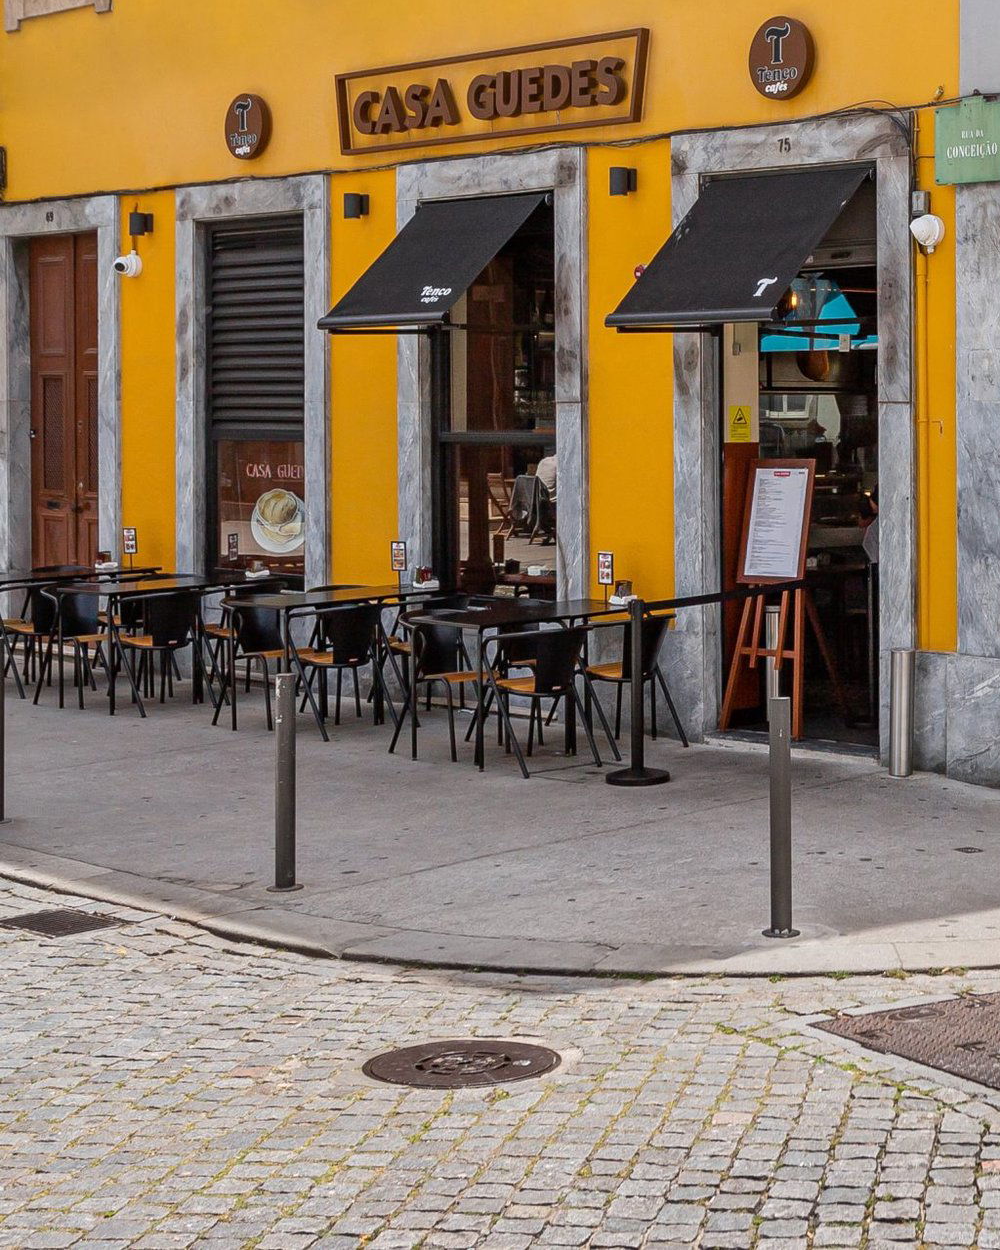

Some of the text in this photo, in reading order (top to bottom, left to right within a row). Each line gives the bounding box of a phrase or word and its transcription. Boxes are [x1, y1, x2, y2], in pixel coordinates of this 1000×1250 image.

[765, 22, 791, 65] T
[757, 65, 798, 83] Tenco
[353, 56, 626, 134] CASA GUEDES
[765, 80, 788, 94] cafés
[777, 137, 791, 153] 75
[946, 140, 998, 159] CONCEIÇÃO
[421, 285, 452, 296] Tenco
[246, 462, 271, 479] CASA
